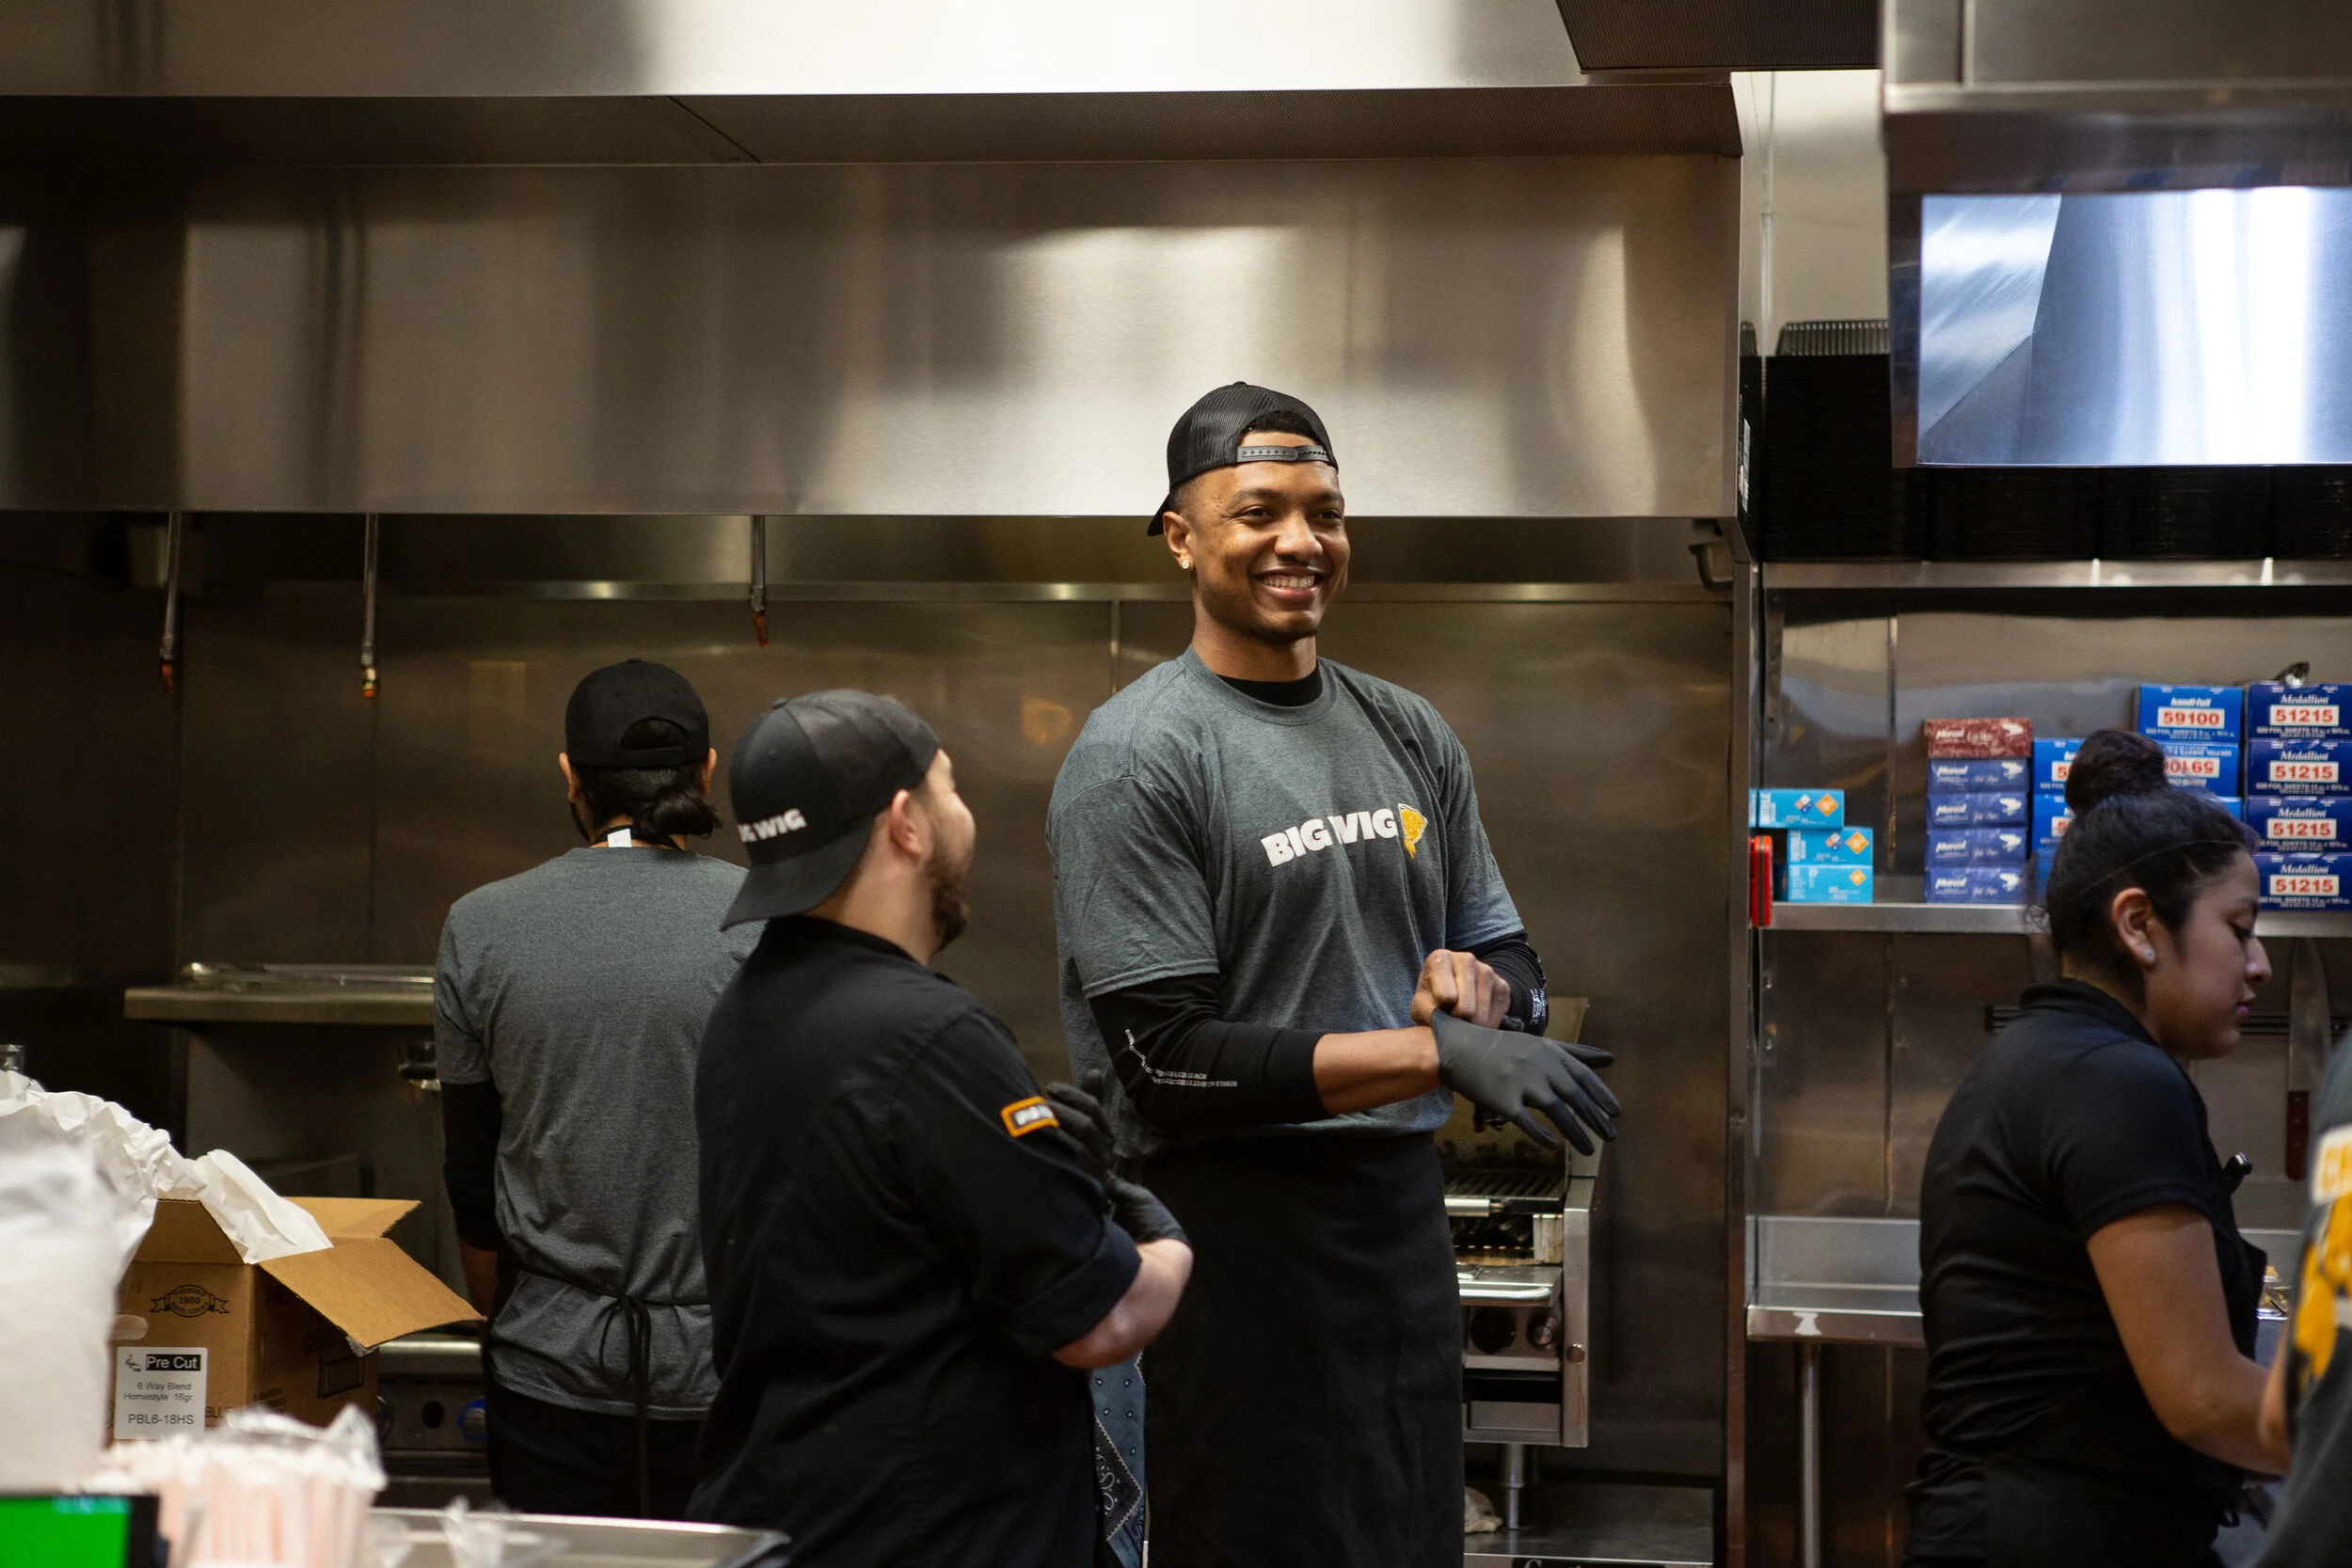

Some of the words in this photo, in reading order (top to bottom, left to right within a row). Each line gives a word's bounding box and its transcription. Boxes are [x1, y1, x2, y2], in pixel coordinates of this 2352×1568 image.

[2164, 711, 2220, 725] 59100
[2276, 709, 2333, 722] 51215
[2275, 765, 2332, 779] 51215
[754, 808, 807, 840] WIG
[2273, 823, 2330, 836] 51215
[1261, 818, 1333, 867] BIG
[2276, 879, 2333, 893] 51215
[147, 1356, 169, 1369] Pre
[173, 1356, 198, 1369] Cut
[146, 1382, 166, 1391] Way
[167, 1382, 192, 1390] Blend
[124, 1393, 168, 1402] Homestyle
[128, 1414, 195, 1425] PBL6-18HS
